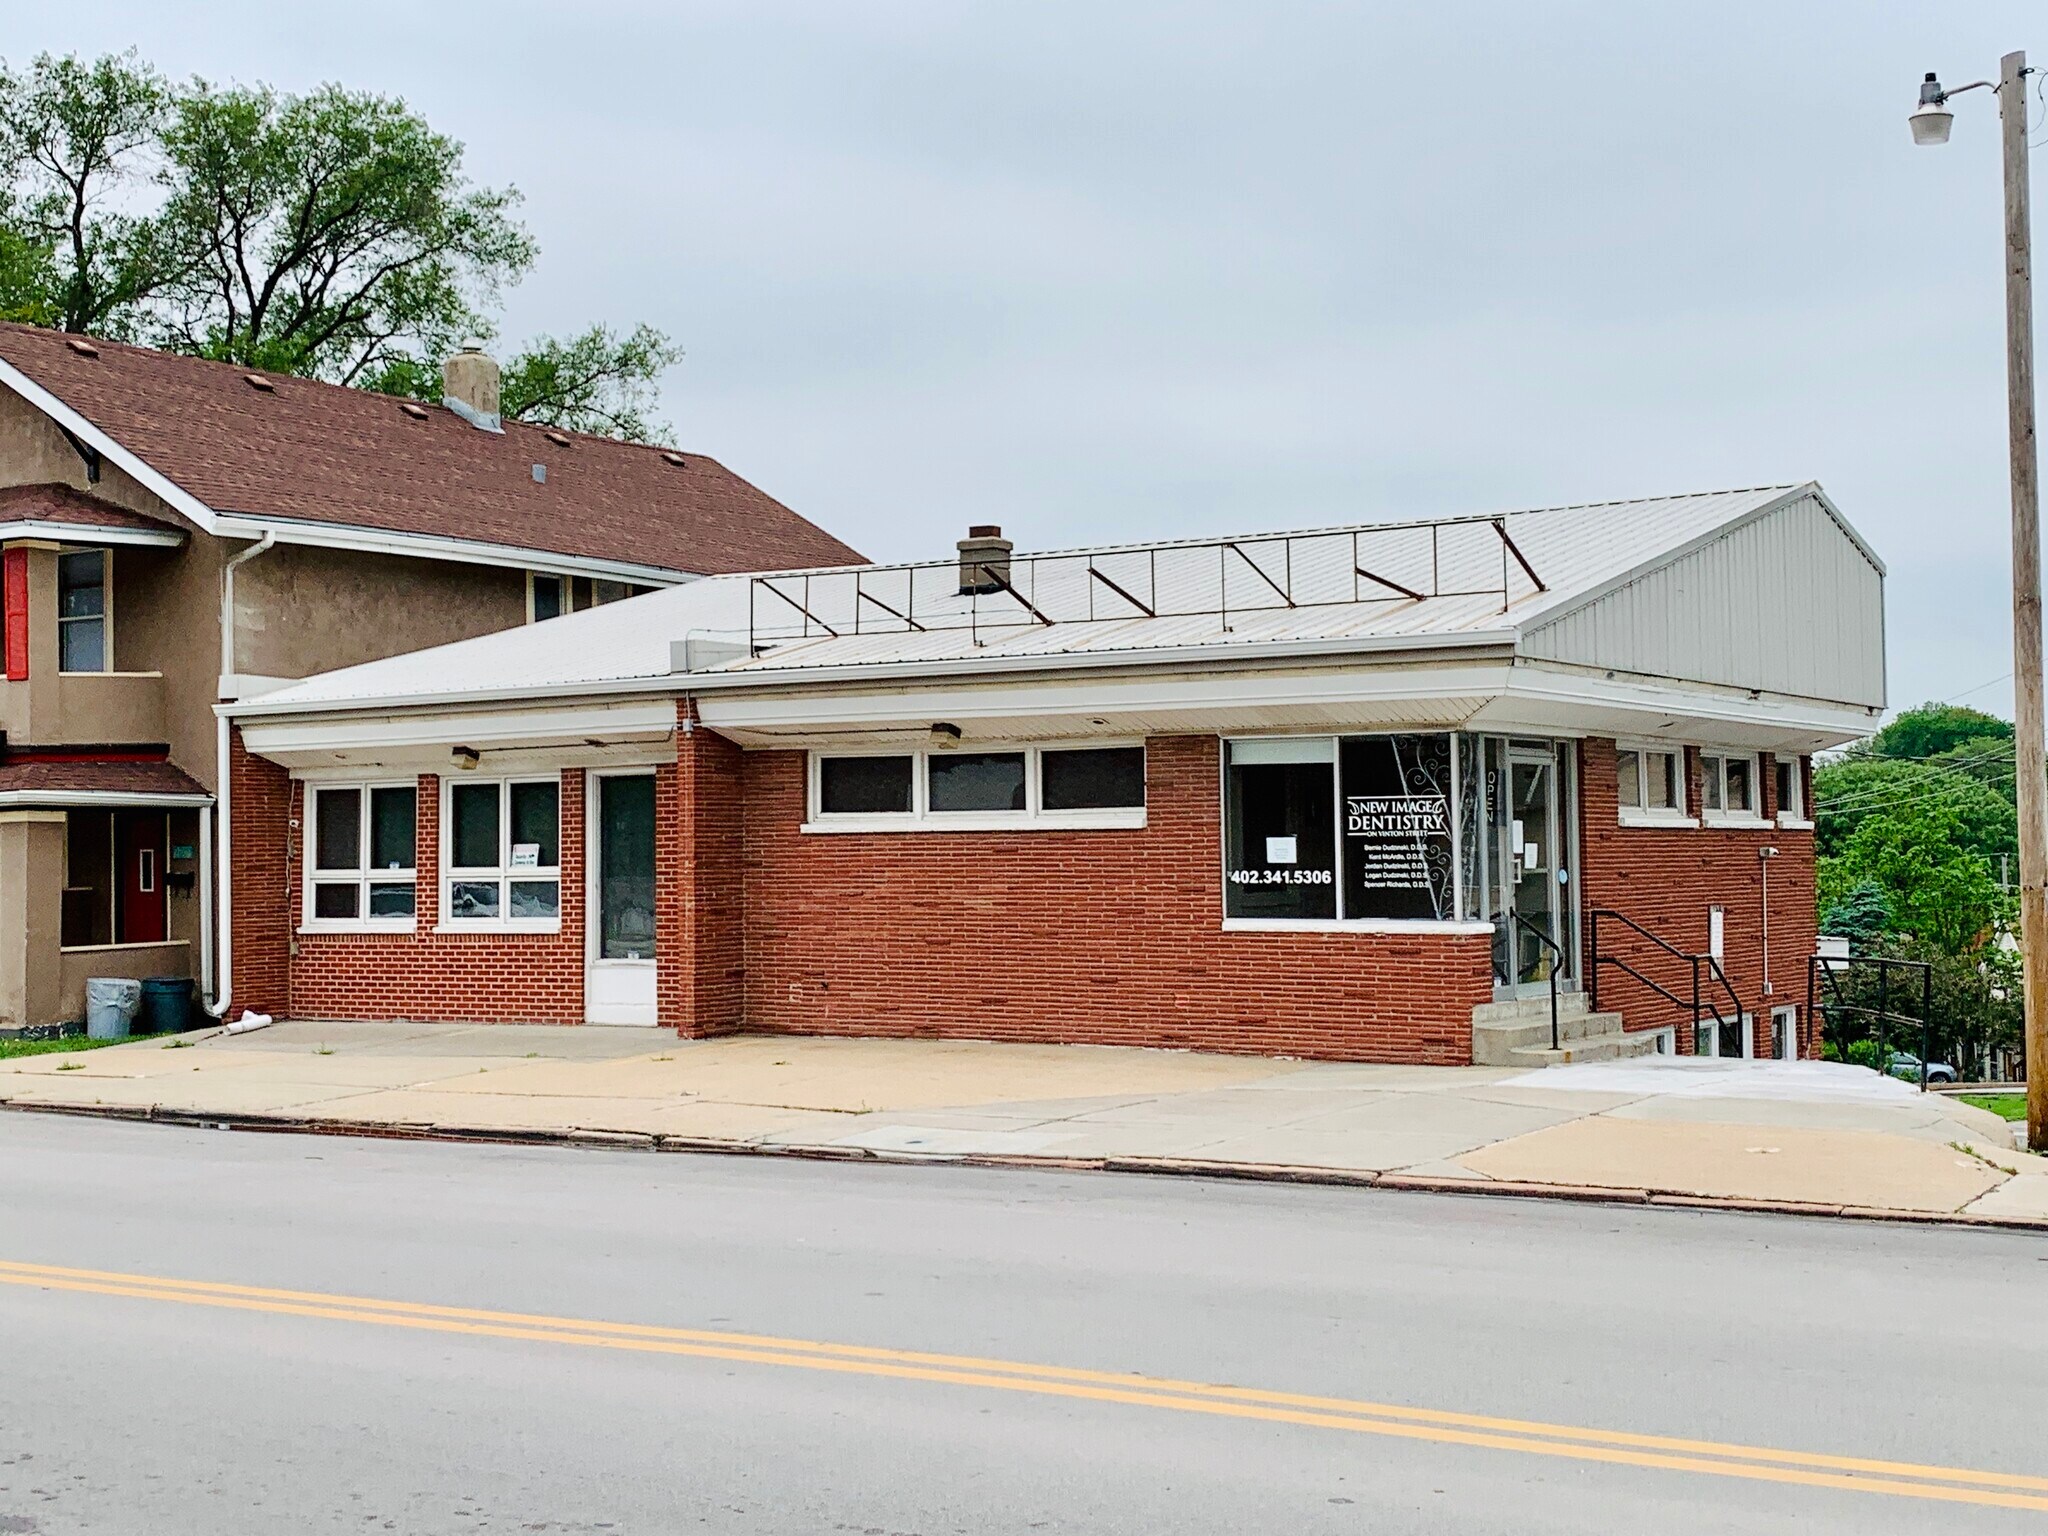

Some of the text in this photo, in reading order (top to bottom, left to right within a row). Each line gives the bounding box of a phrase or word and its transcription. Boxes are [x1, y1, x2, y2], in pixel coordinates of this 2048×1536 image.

[1486, 771, 1496, 822] OPEN
[1360, 800, 1433, 814] NEW IMAGE
[1348, 815, 1445, 831] DENTISTRY
[1230, 870, 1332, 884] 402.341.5306
